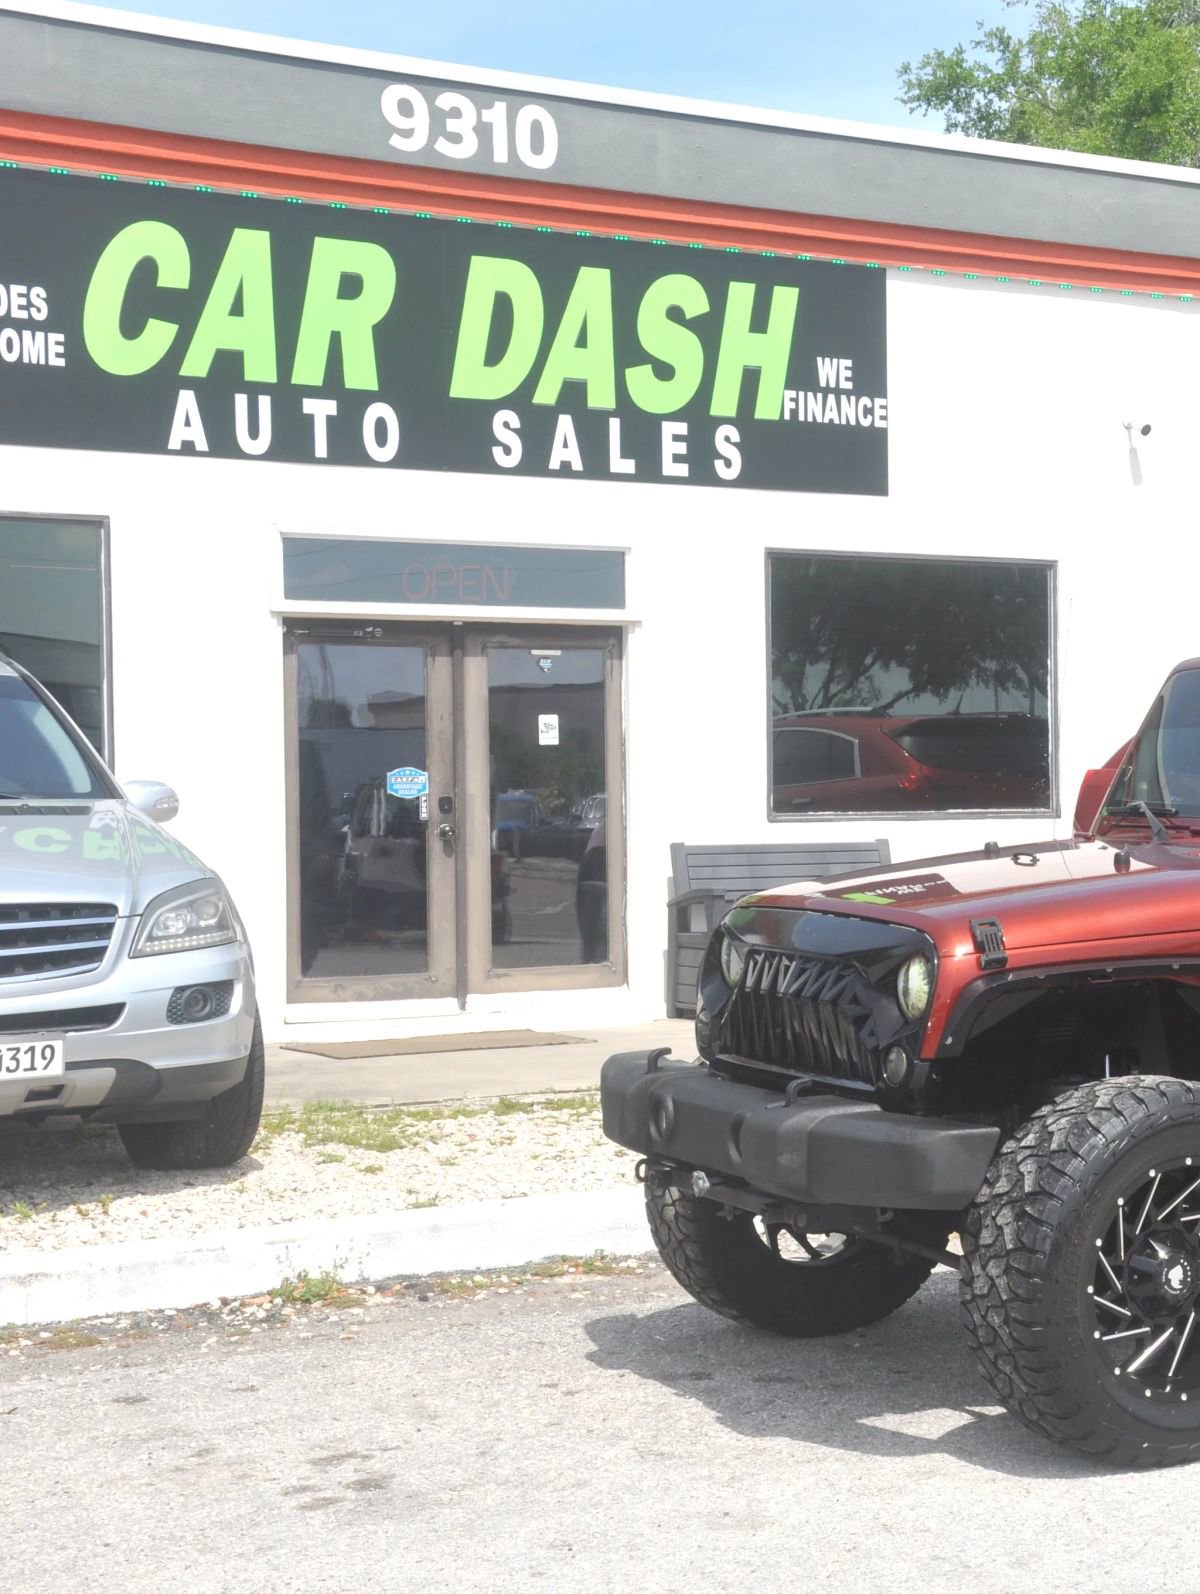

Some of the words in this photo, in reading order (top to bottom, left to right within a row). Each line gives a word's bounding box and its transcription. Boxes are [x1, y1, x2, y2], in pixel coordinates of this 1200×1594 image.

[381, 84, 558, 169] 9310
[83, 220, 397, 390] CAR
[448, 255, 799, 420] DASH
[816, 356, 853, 389] WE
[168, 389, 400, 463] AUTO
[491, 409, 742, 481] SALES
[783, 389, 888, 428] FINANCE
[402, 562, 509, 601] OPEN
